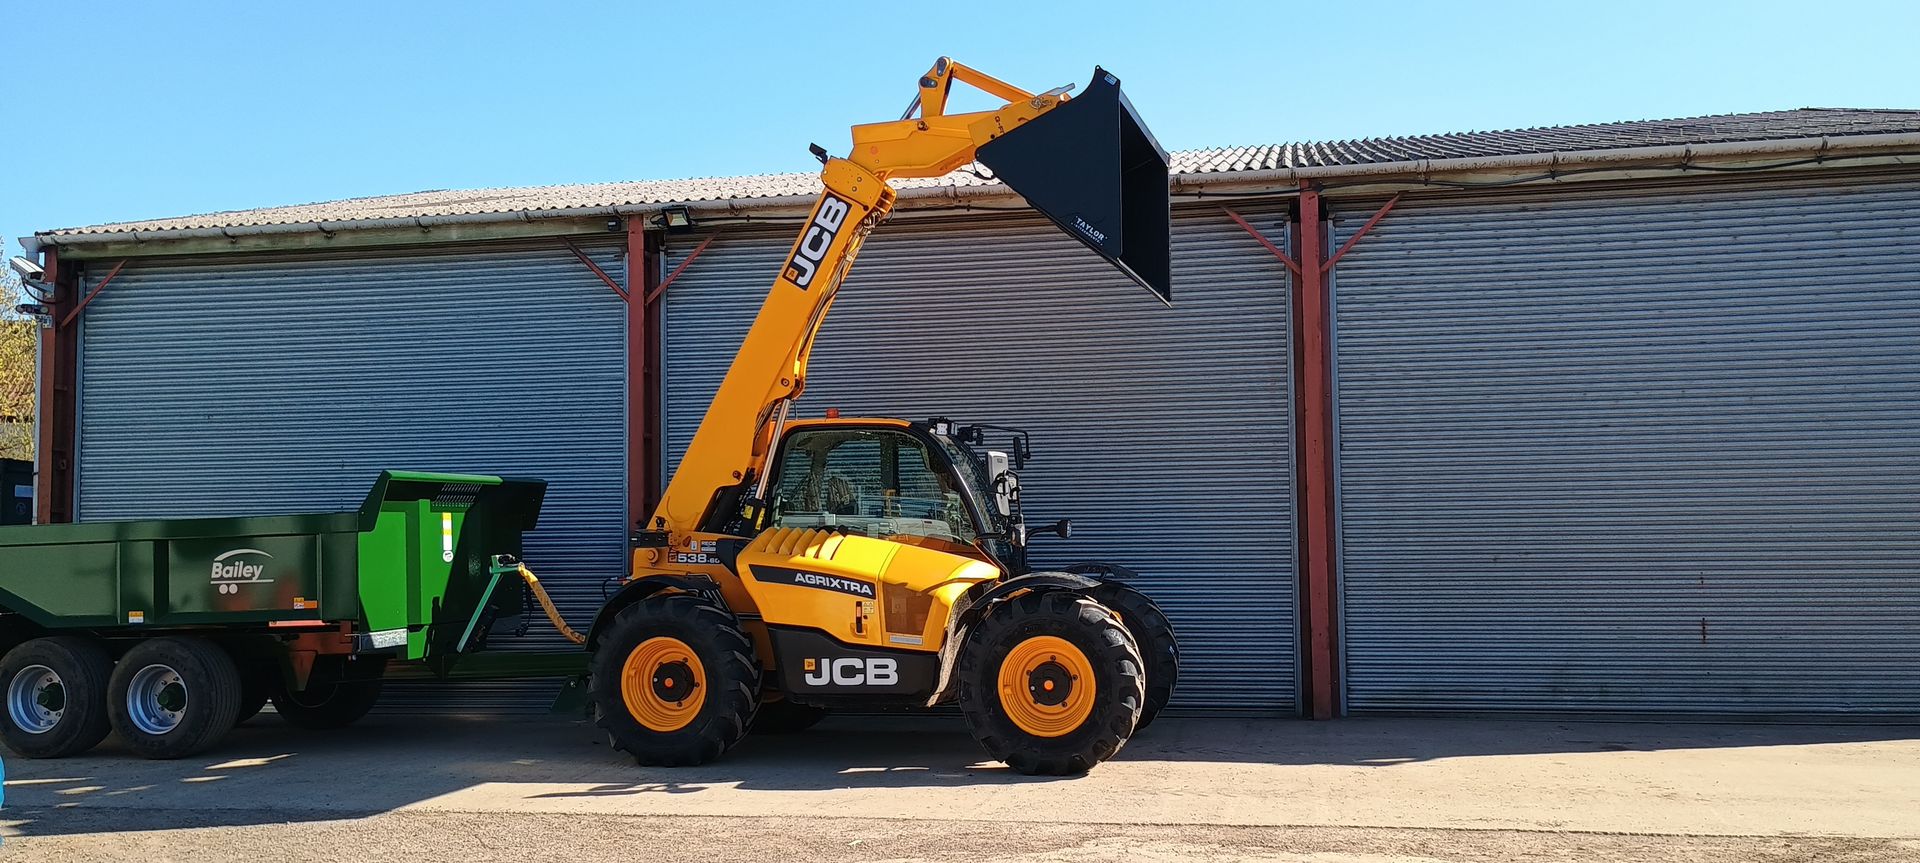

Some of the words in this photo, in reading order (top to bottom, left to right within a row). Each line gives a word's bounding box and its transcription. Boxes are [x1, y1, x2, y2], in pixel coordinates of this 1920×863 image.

[1077, 217, 1105, 241] TAYLOR
[793, 197, 848, 286] JCB
[211, 561, 263, 581] Bailey
[794, 572, 873, 596] AGRIXTRA
[804, 658, 898, 686] JCB
